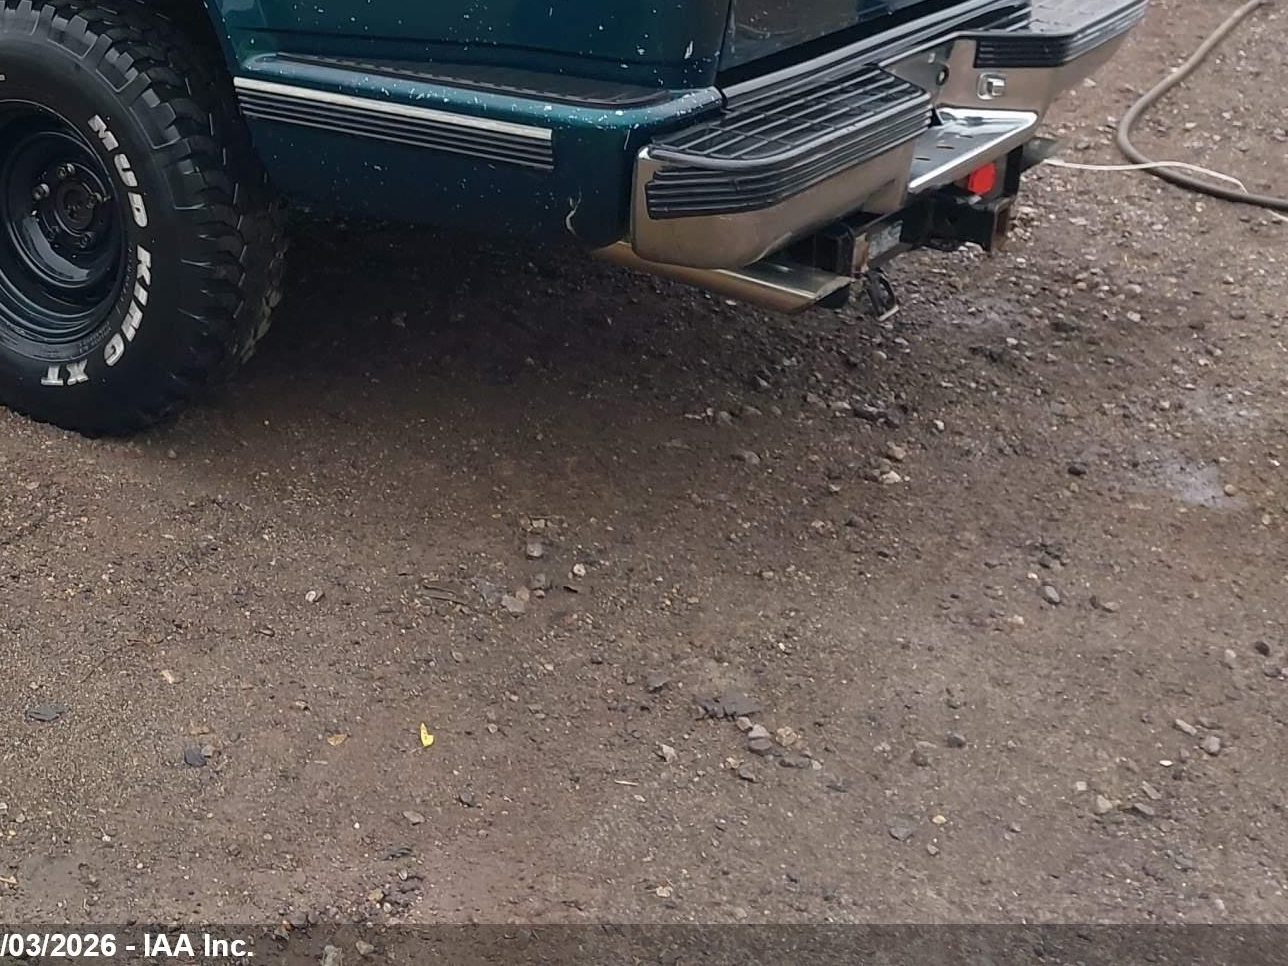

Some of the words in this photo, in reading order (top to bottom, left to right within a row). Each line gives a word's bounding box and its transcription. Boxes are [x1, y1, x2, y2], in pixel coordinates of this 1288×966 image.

[88, 114, 149, 228] MUD
[103, 243, 152, 367] KING
[40, 359, 90, 386] XT
